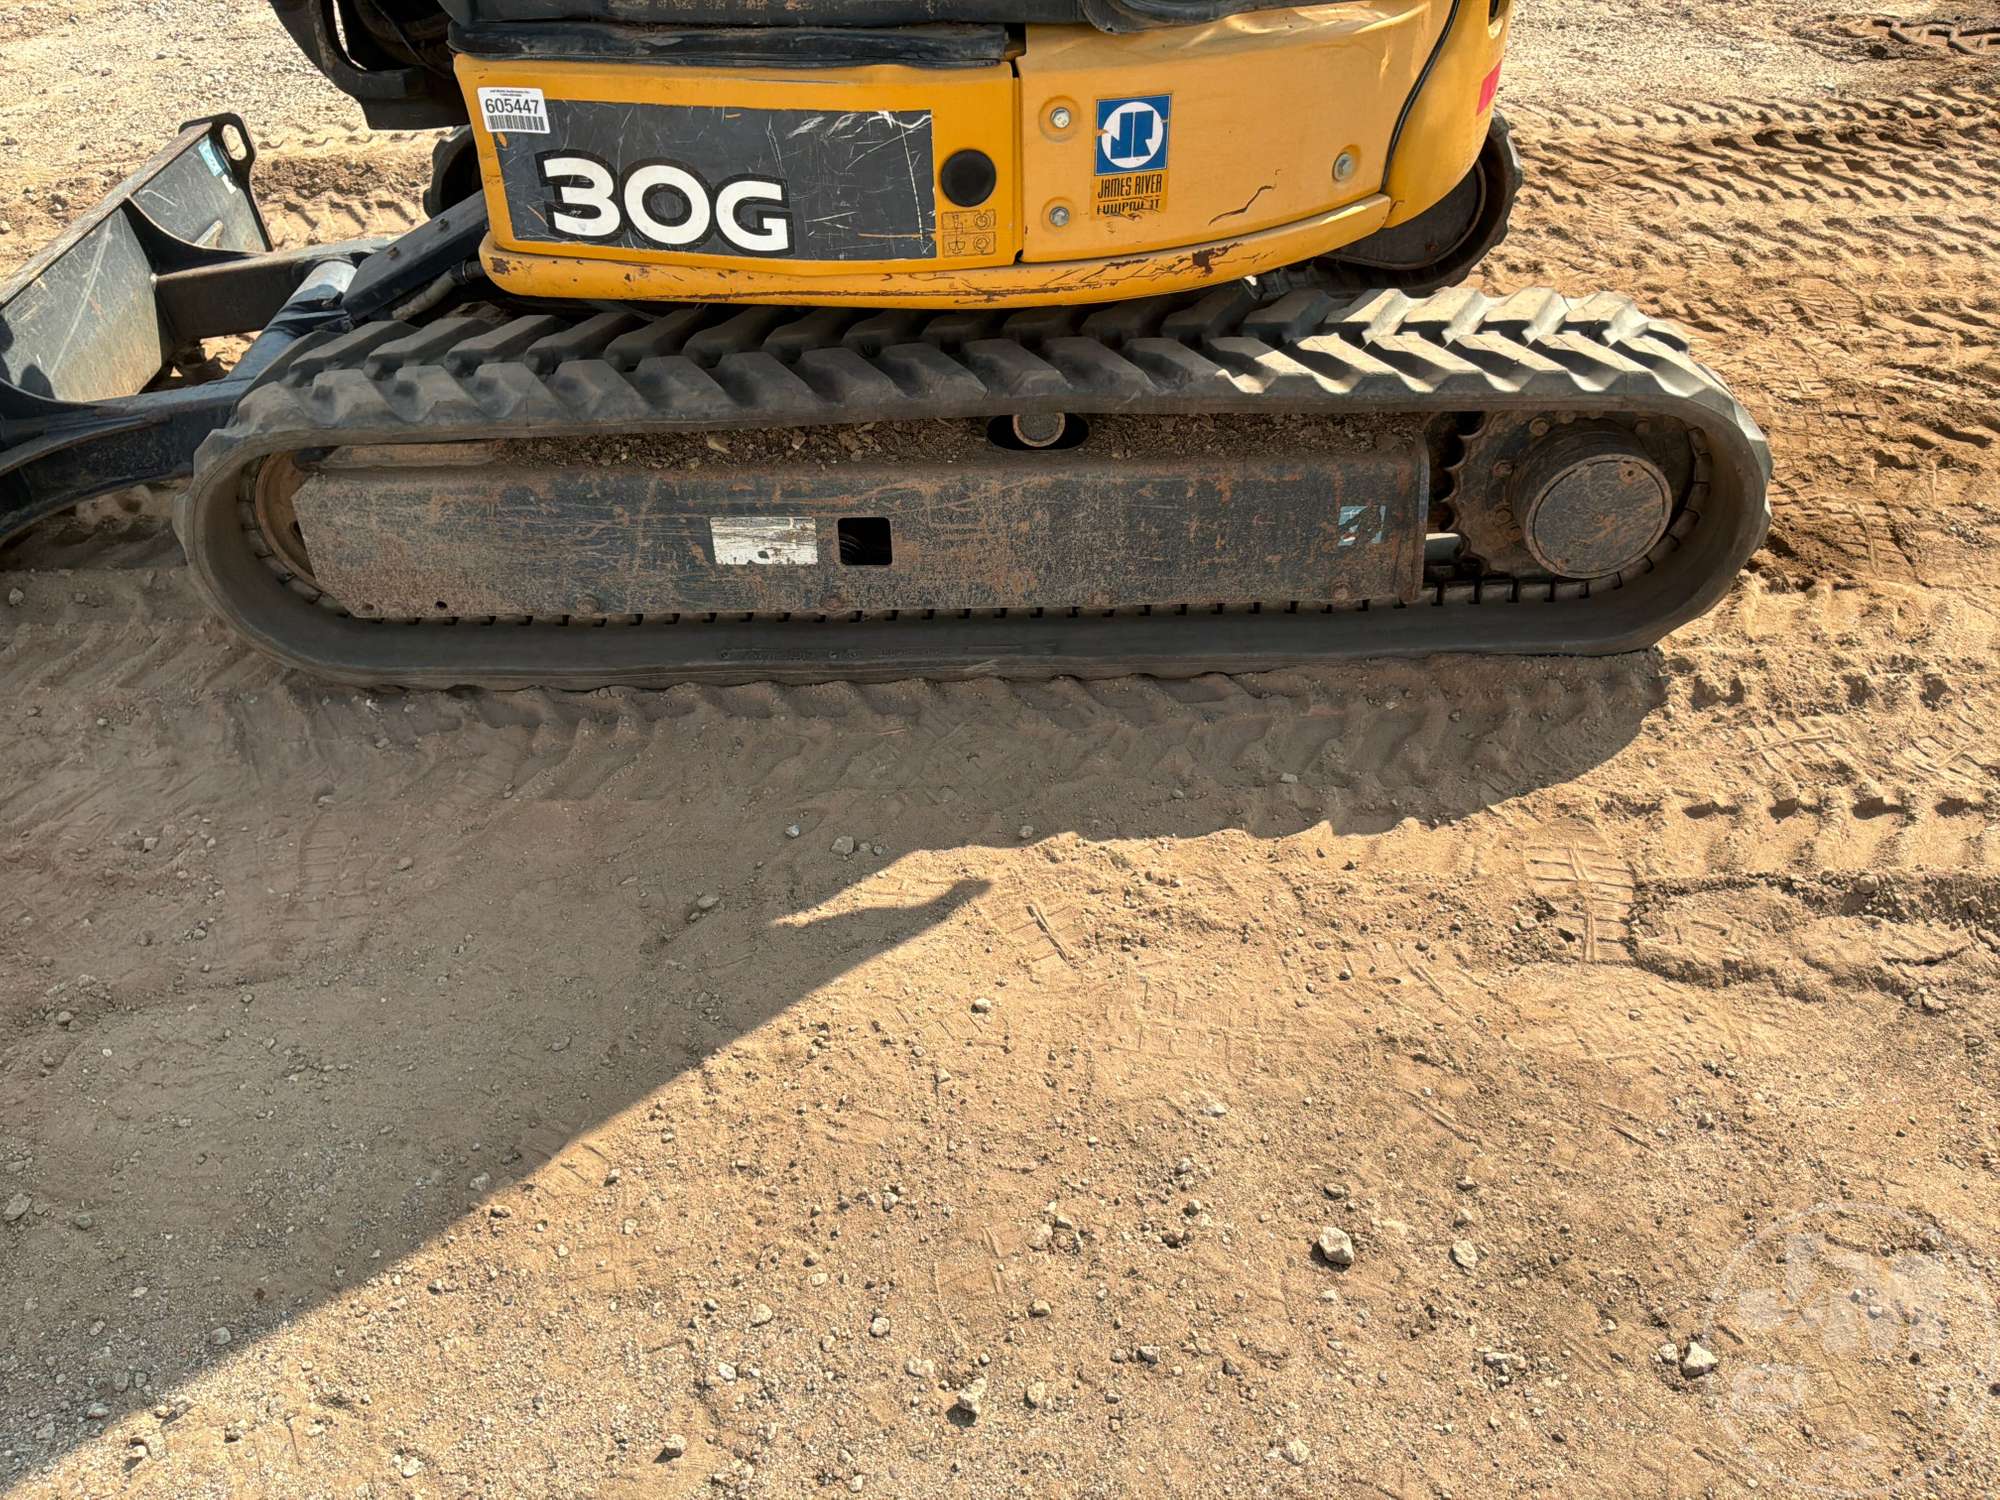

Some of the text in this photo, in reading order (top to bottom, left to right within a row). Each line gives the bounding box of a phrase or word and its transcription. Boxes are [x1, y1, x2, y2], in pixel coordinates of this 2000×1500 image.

[485, 98, 539, 114] 605447
[1097, 174, 1163, 199] JAMES RIVER
[543, 157, 789, 251] 30G
